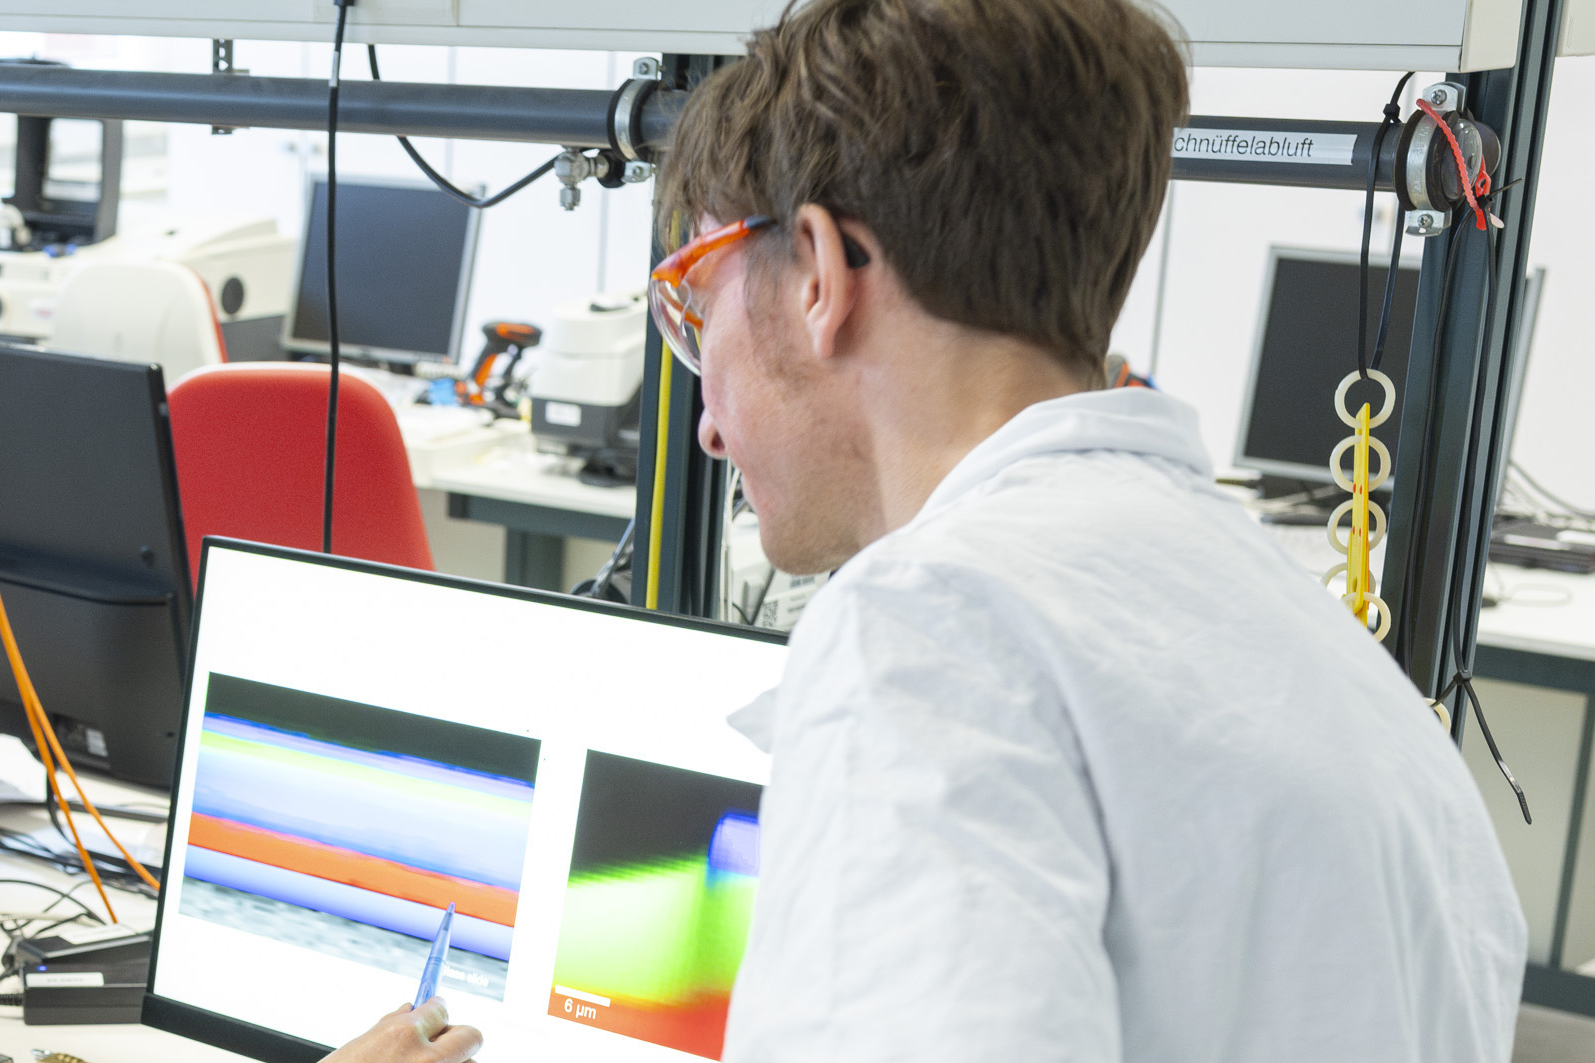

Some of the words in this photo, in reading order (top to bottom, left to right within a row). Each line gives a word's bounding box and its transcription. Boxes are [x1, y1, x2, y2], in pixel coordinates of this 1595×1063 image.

[1174, 132, 1314, 158] chnüffelabluft
[564, 998, 574, 1013] 6
[575, 1003, 597, 1020] µm
